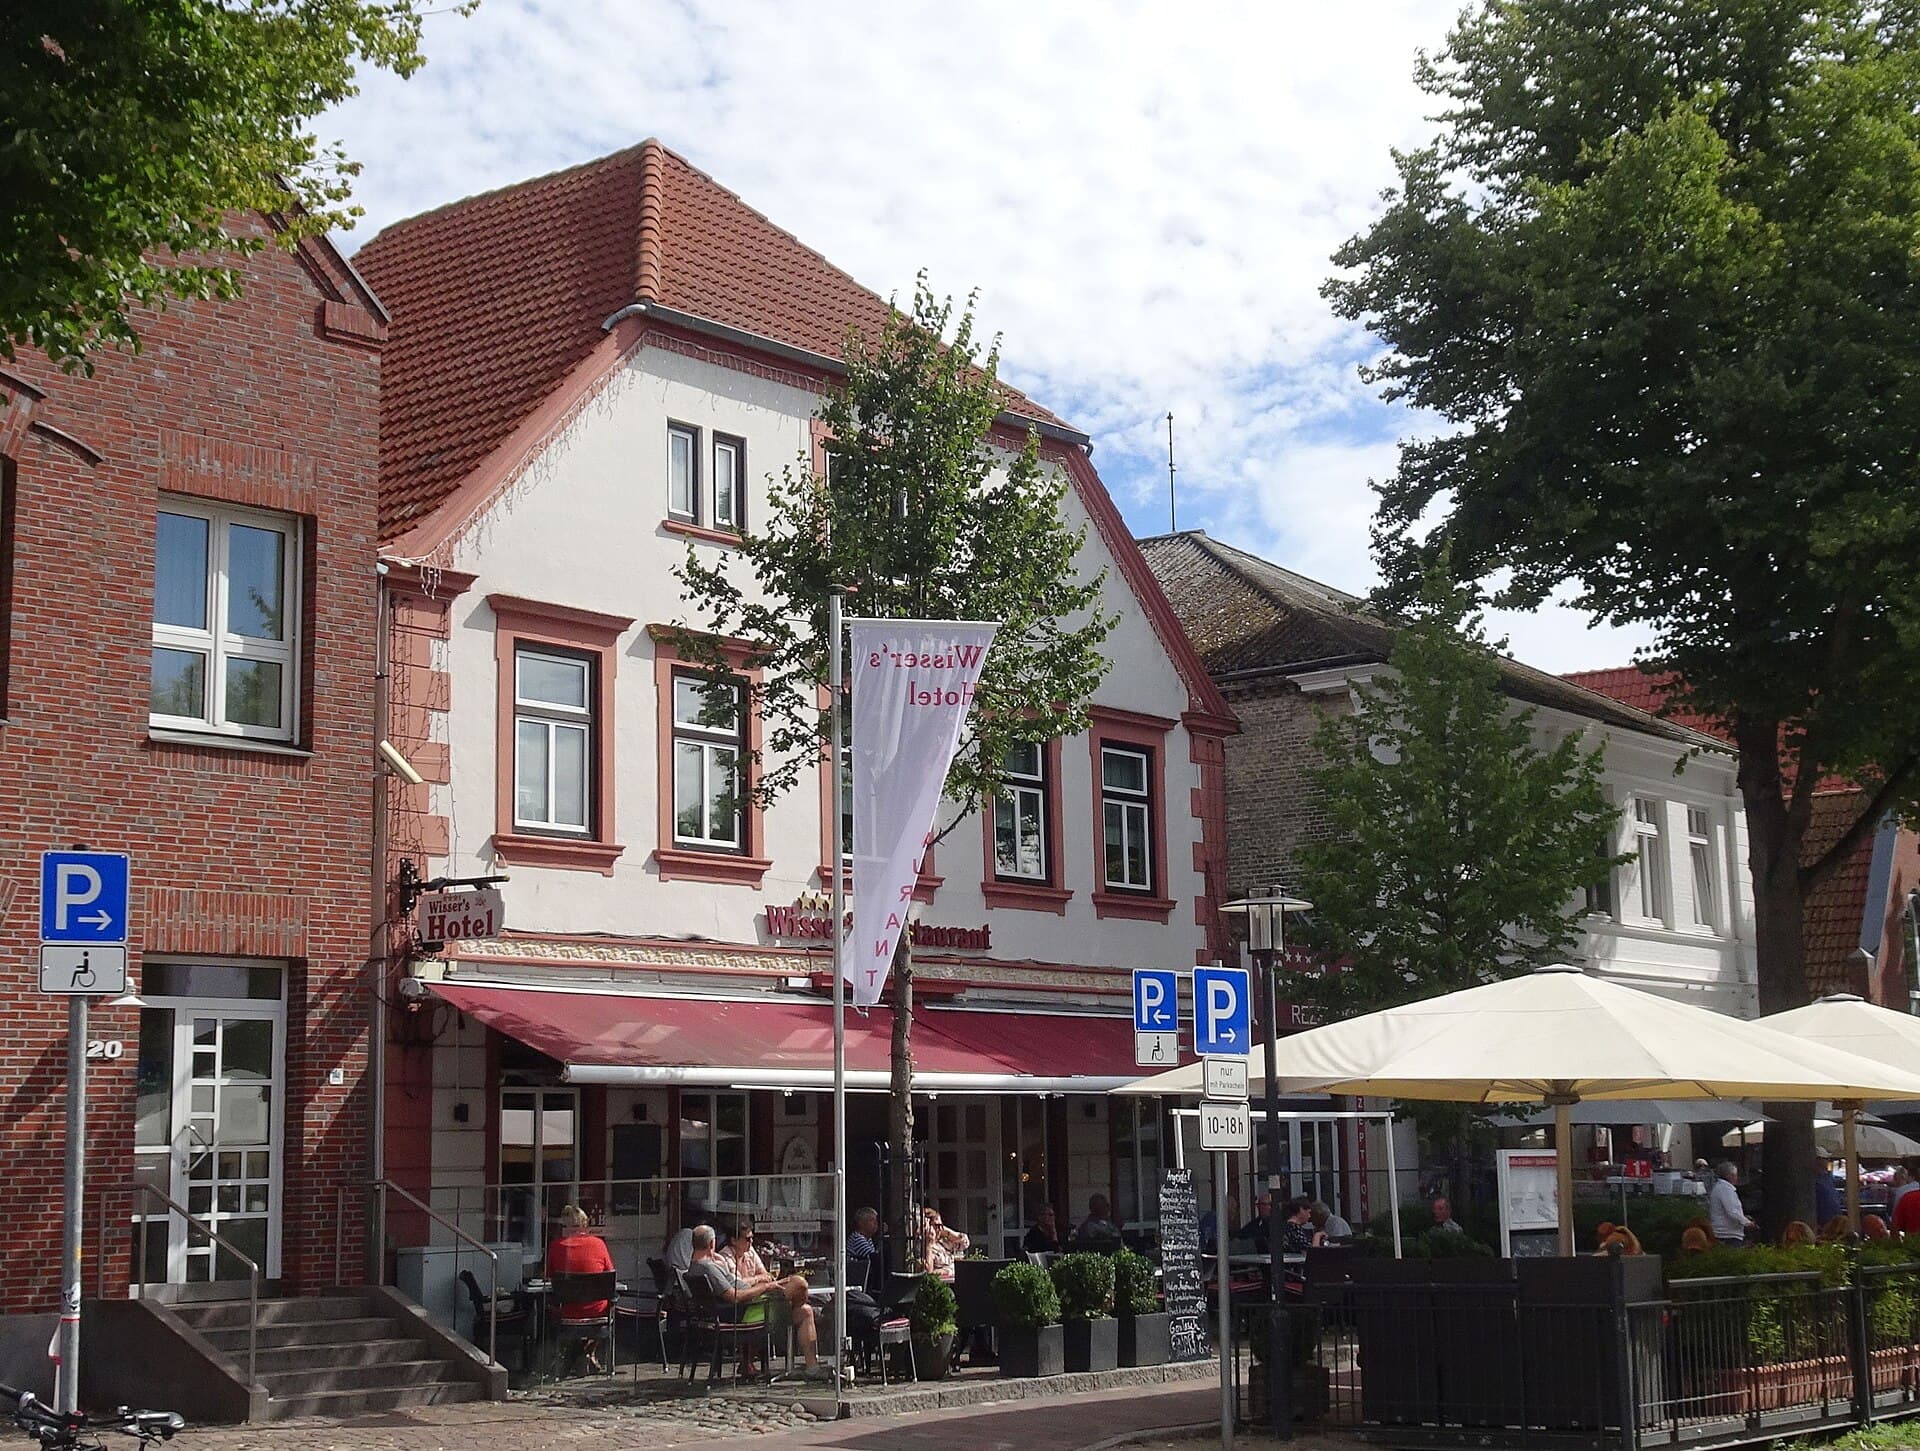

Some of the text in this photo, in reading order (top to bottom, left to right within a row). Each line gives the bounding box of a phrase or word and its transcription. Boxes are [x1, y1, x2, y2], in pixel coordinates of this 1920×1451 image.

[55, 863, 102, 930] P
[428, 898, 471, 914] Wisser's
[427, 909, 494, 940] Hotel
[1141, 978, 1165, 1024] P
[1206, 979, 1237, 1044] P
[86, 1040, 123, 1058] 20
[1220, 1067, 1234, 1077] nur
